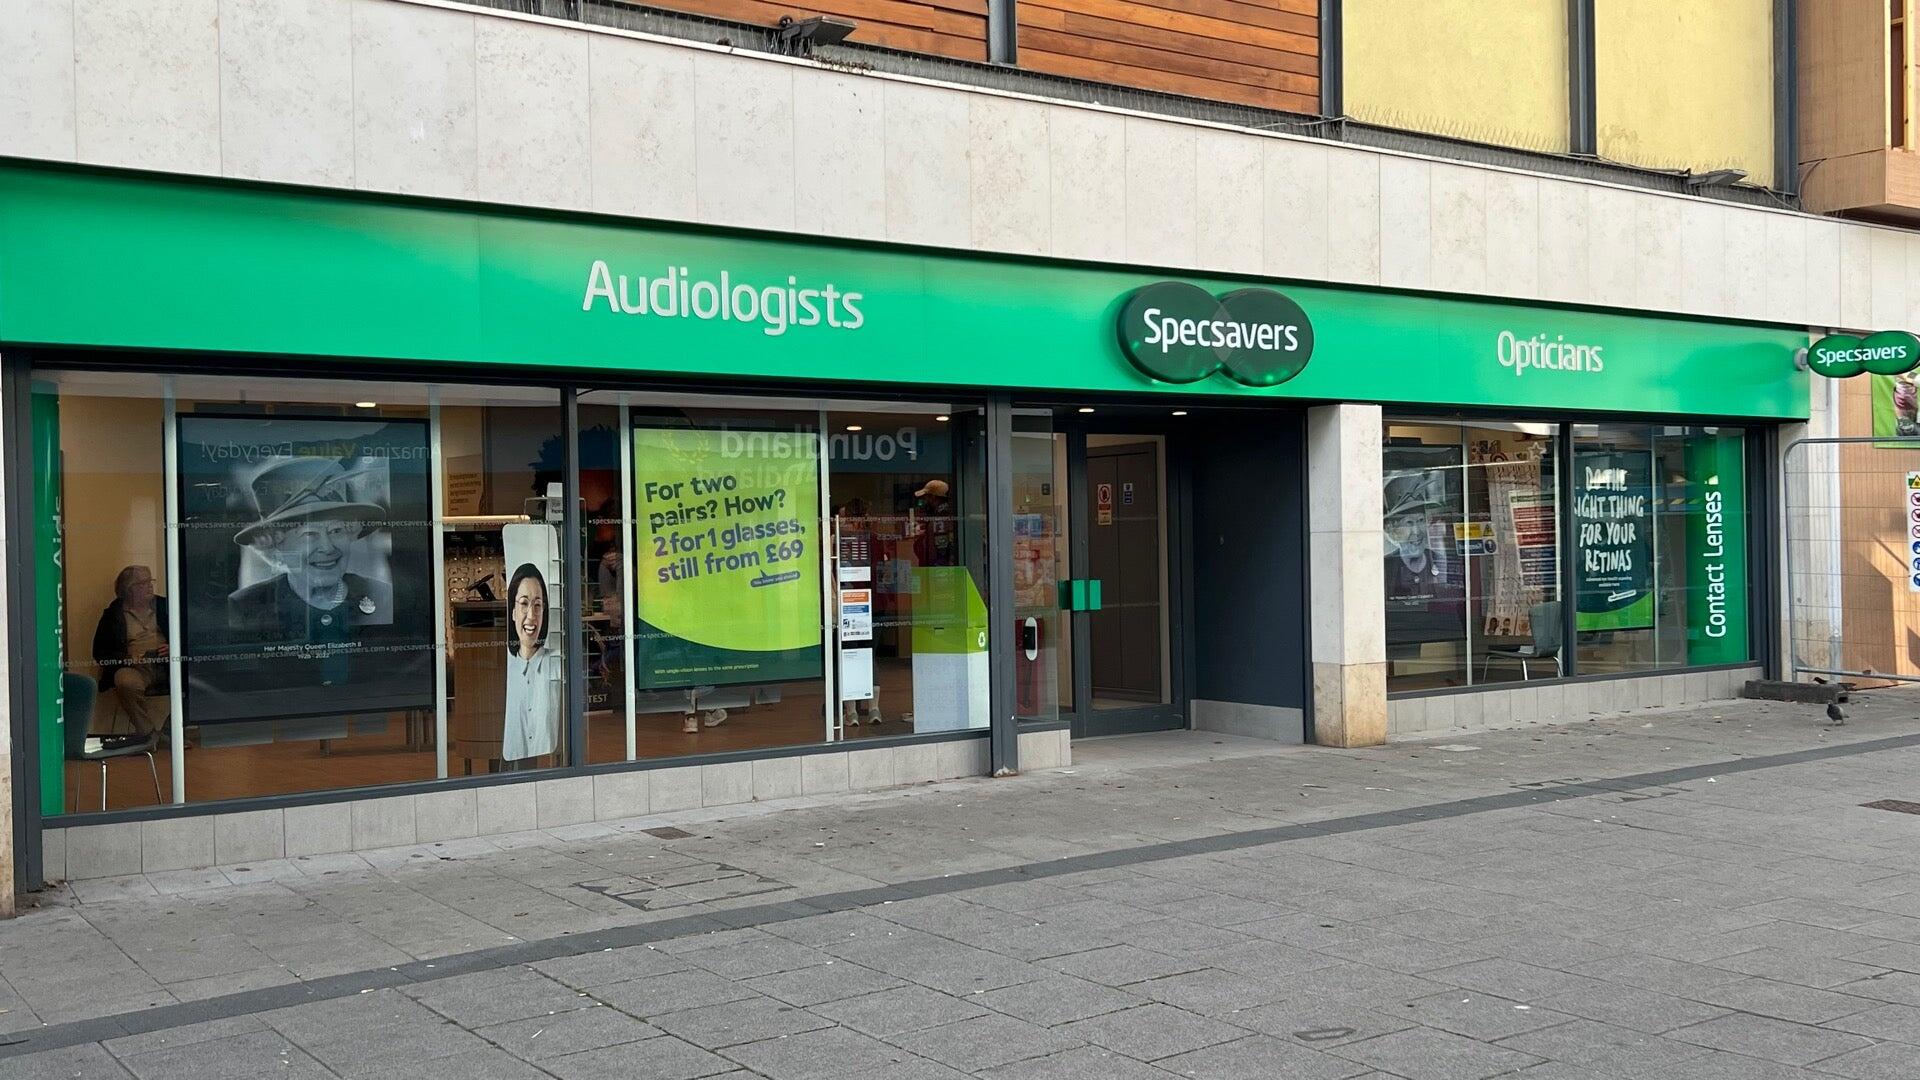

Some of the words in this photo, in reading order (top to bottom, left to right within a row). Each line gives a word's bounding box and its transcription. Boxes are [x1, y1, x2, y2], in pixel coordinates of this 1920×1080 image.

[582, 259, 864, 336] Audiologists
[1143, 308, 1298, 353] Specsavers
[1497, 330, 1604, 376] Opticians
[1816, 345, 1907, 367] Specsavers
[644, 481, 684, 502] For
[690, 475, 737, 496] two
[1573, 492, 1606, 519] IGHT
[1608, 495, 1644, 519] THING
[650, 499, 718, 534] pairs?
[724, 488, 786, 516] How?
[1703, 491, 1723, 557] Lenses
[653, 537, 668, 557] 2
[669, 532, 705, 553] for
[708, 527, 717, 547] 1
[721, 518, 805, 550] glasses,
[1579, 523, 1602, 548] FOR
[1606, 522, 1636, 545] YOUR
[658, 557, 699, 583] still
[705, 551, 760, 574] from
[765, 539, 804, 564] £69
[1585, 548, 1632, 573] RETINAS
[1705, 563, 1726, 638] Contact
